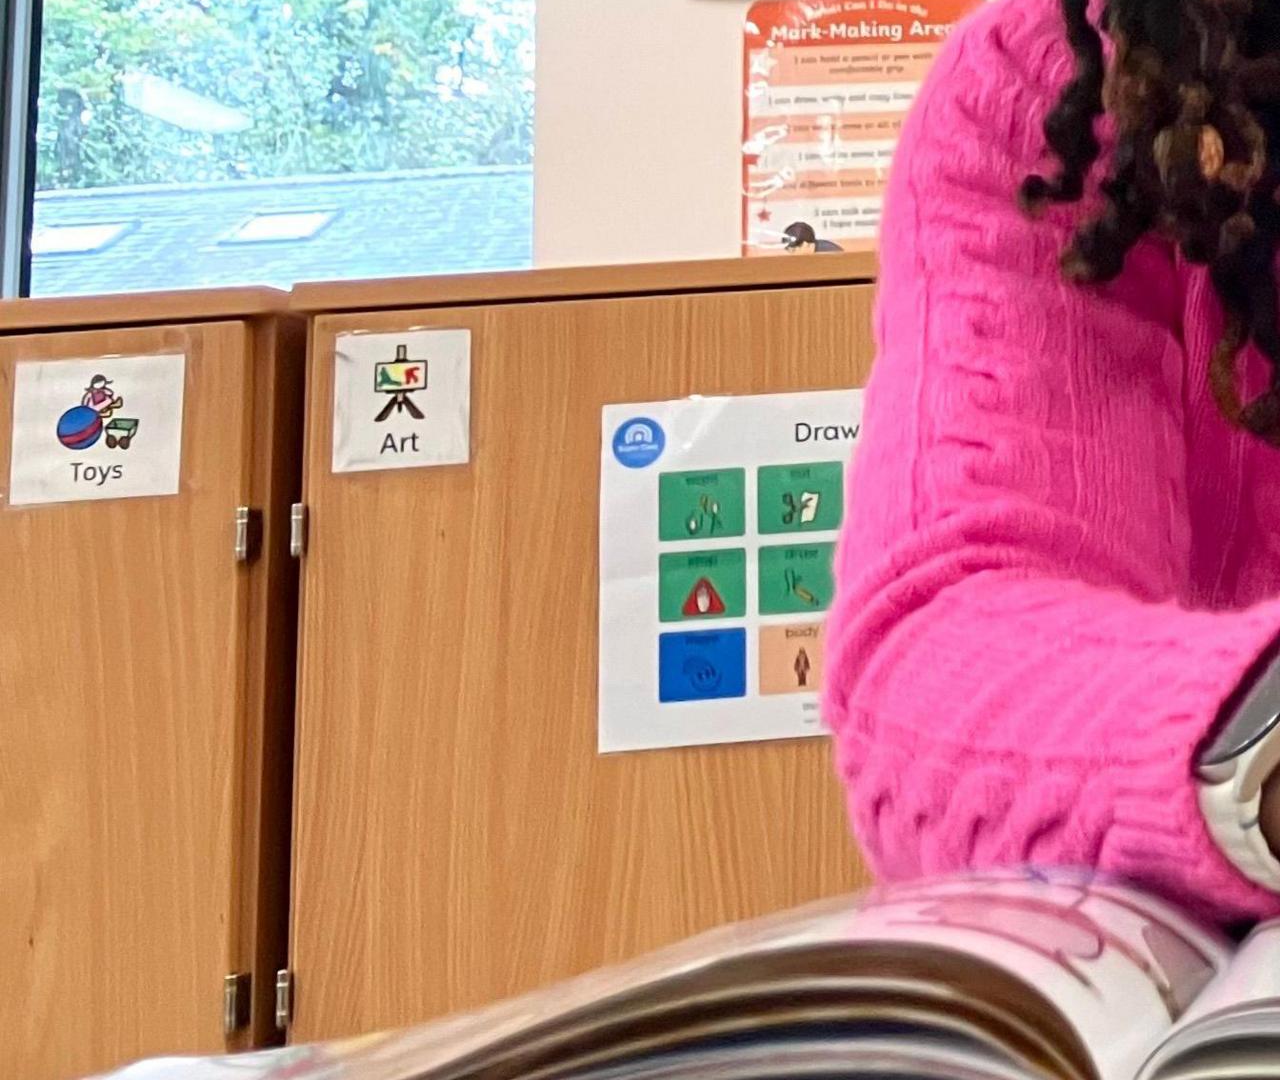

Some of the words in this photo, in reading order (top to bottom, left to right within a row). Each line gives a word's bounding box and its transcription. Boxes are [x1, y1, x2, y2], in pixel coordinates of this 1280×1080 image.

[770, 19, 903, 42] Mark-Making
[379, 432, 420, 455] Art
[795, 422, 860, 443] Draw
[70, 461, 123, 487] Toys
